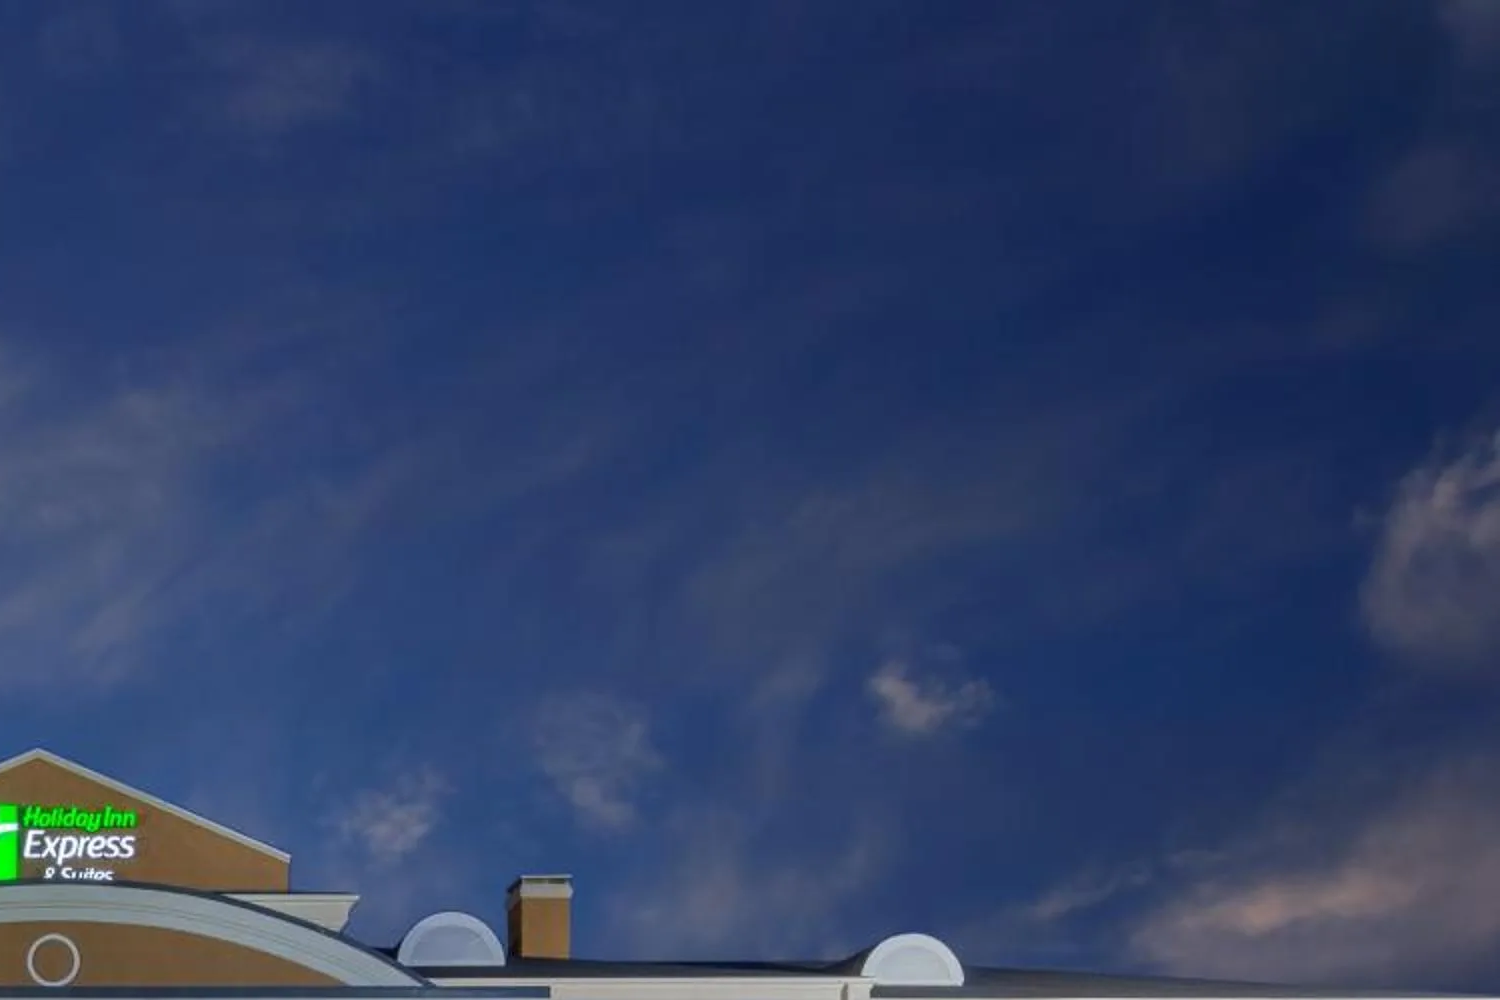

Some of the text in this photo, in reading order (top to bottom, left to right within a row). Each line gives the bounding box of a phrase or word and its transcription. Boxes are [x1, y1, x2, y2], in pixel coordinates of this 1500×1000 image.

[24, 803, 137, 832] Holiday Inn
[23, 829, 136, 866] Express
